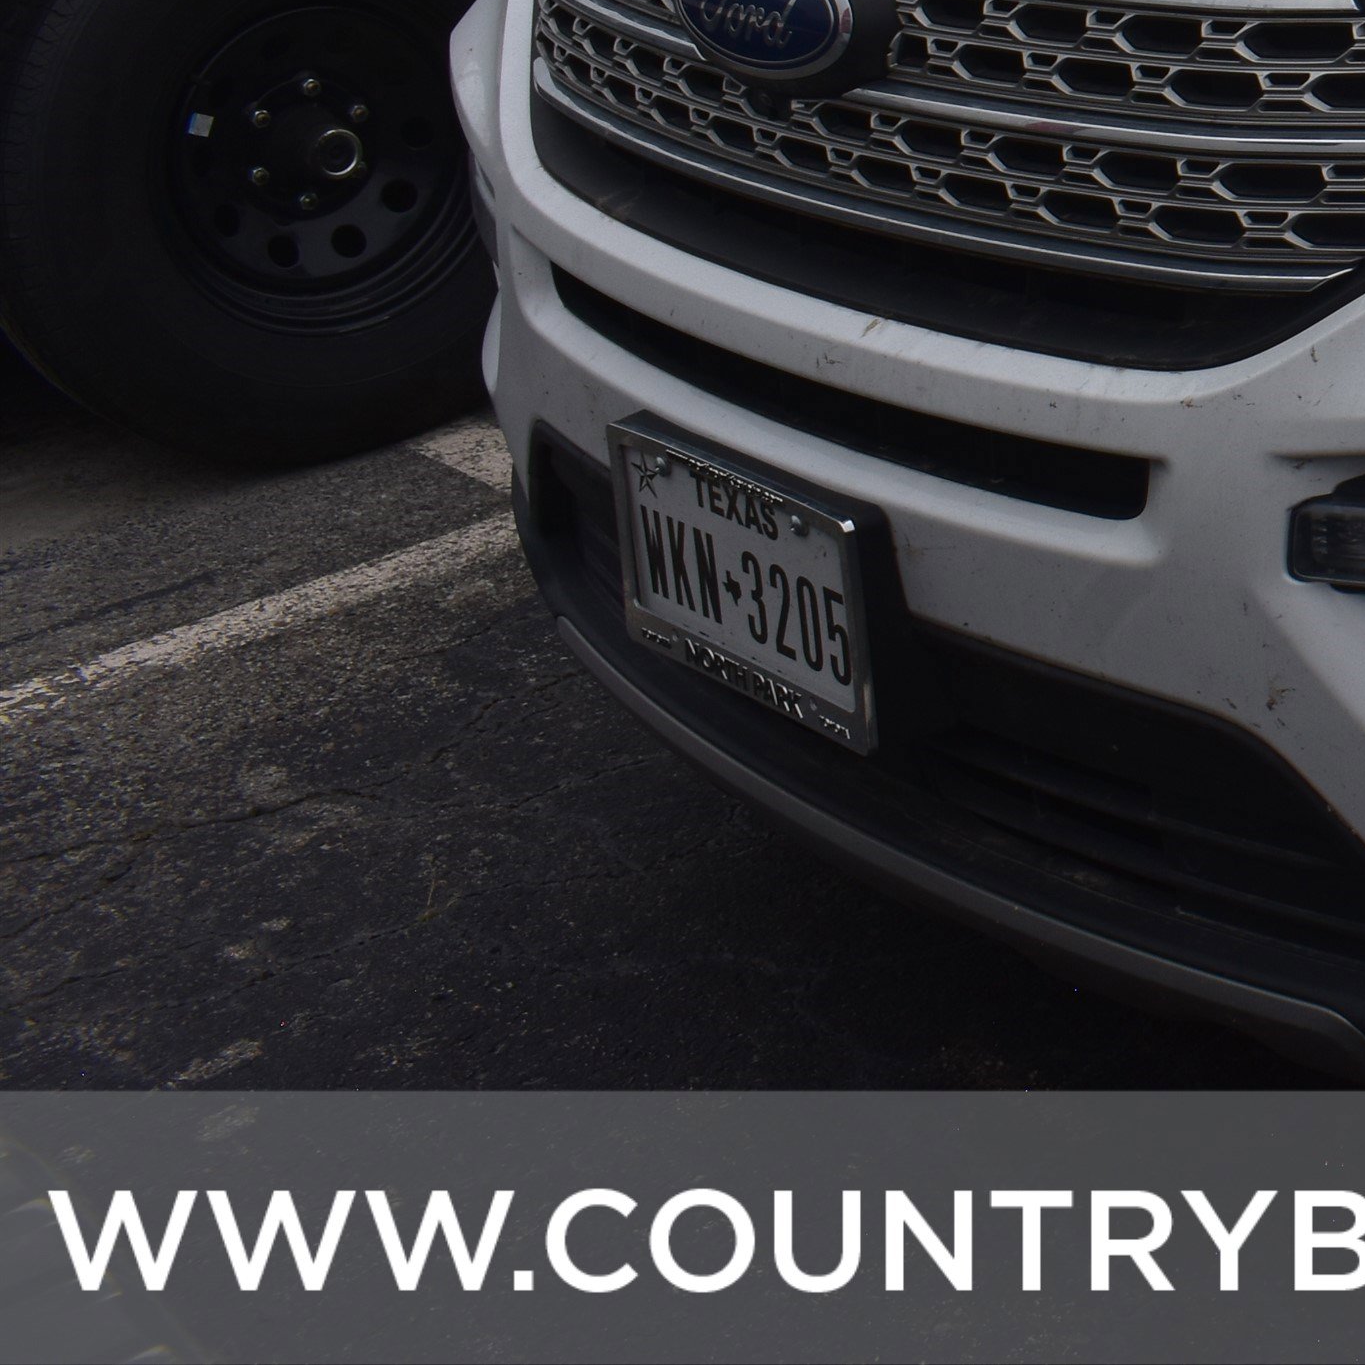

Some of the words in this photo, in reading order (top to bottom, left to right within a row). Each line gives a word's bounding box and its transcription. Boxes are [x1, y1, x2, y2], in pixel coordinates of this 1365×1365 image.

[689, 470, 779, 541] TEXAS
[685, 637, 748, 688] NORTH
[752, 671, 803, 720] PARK
